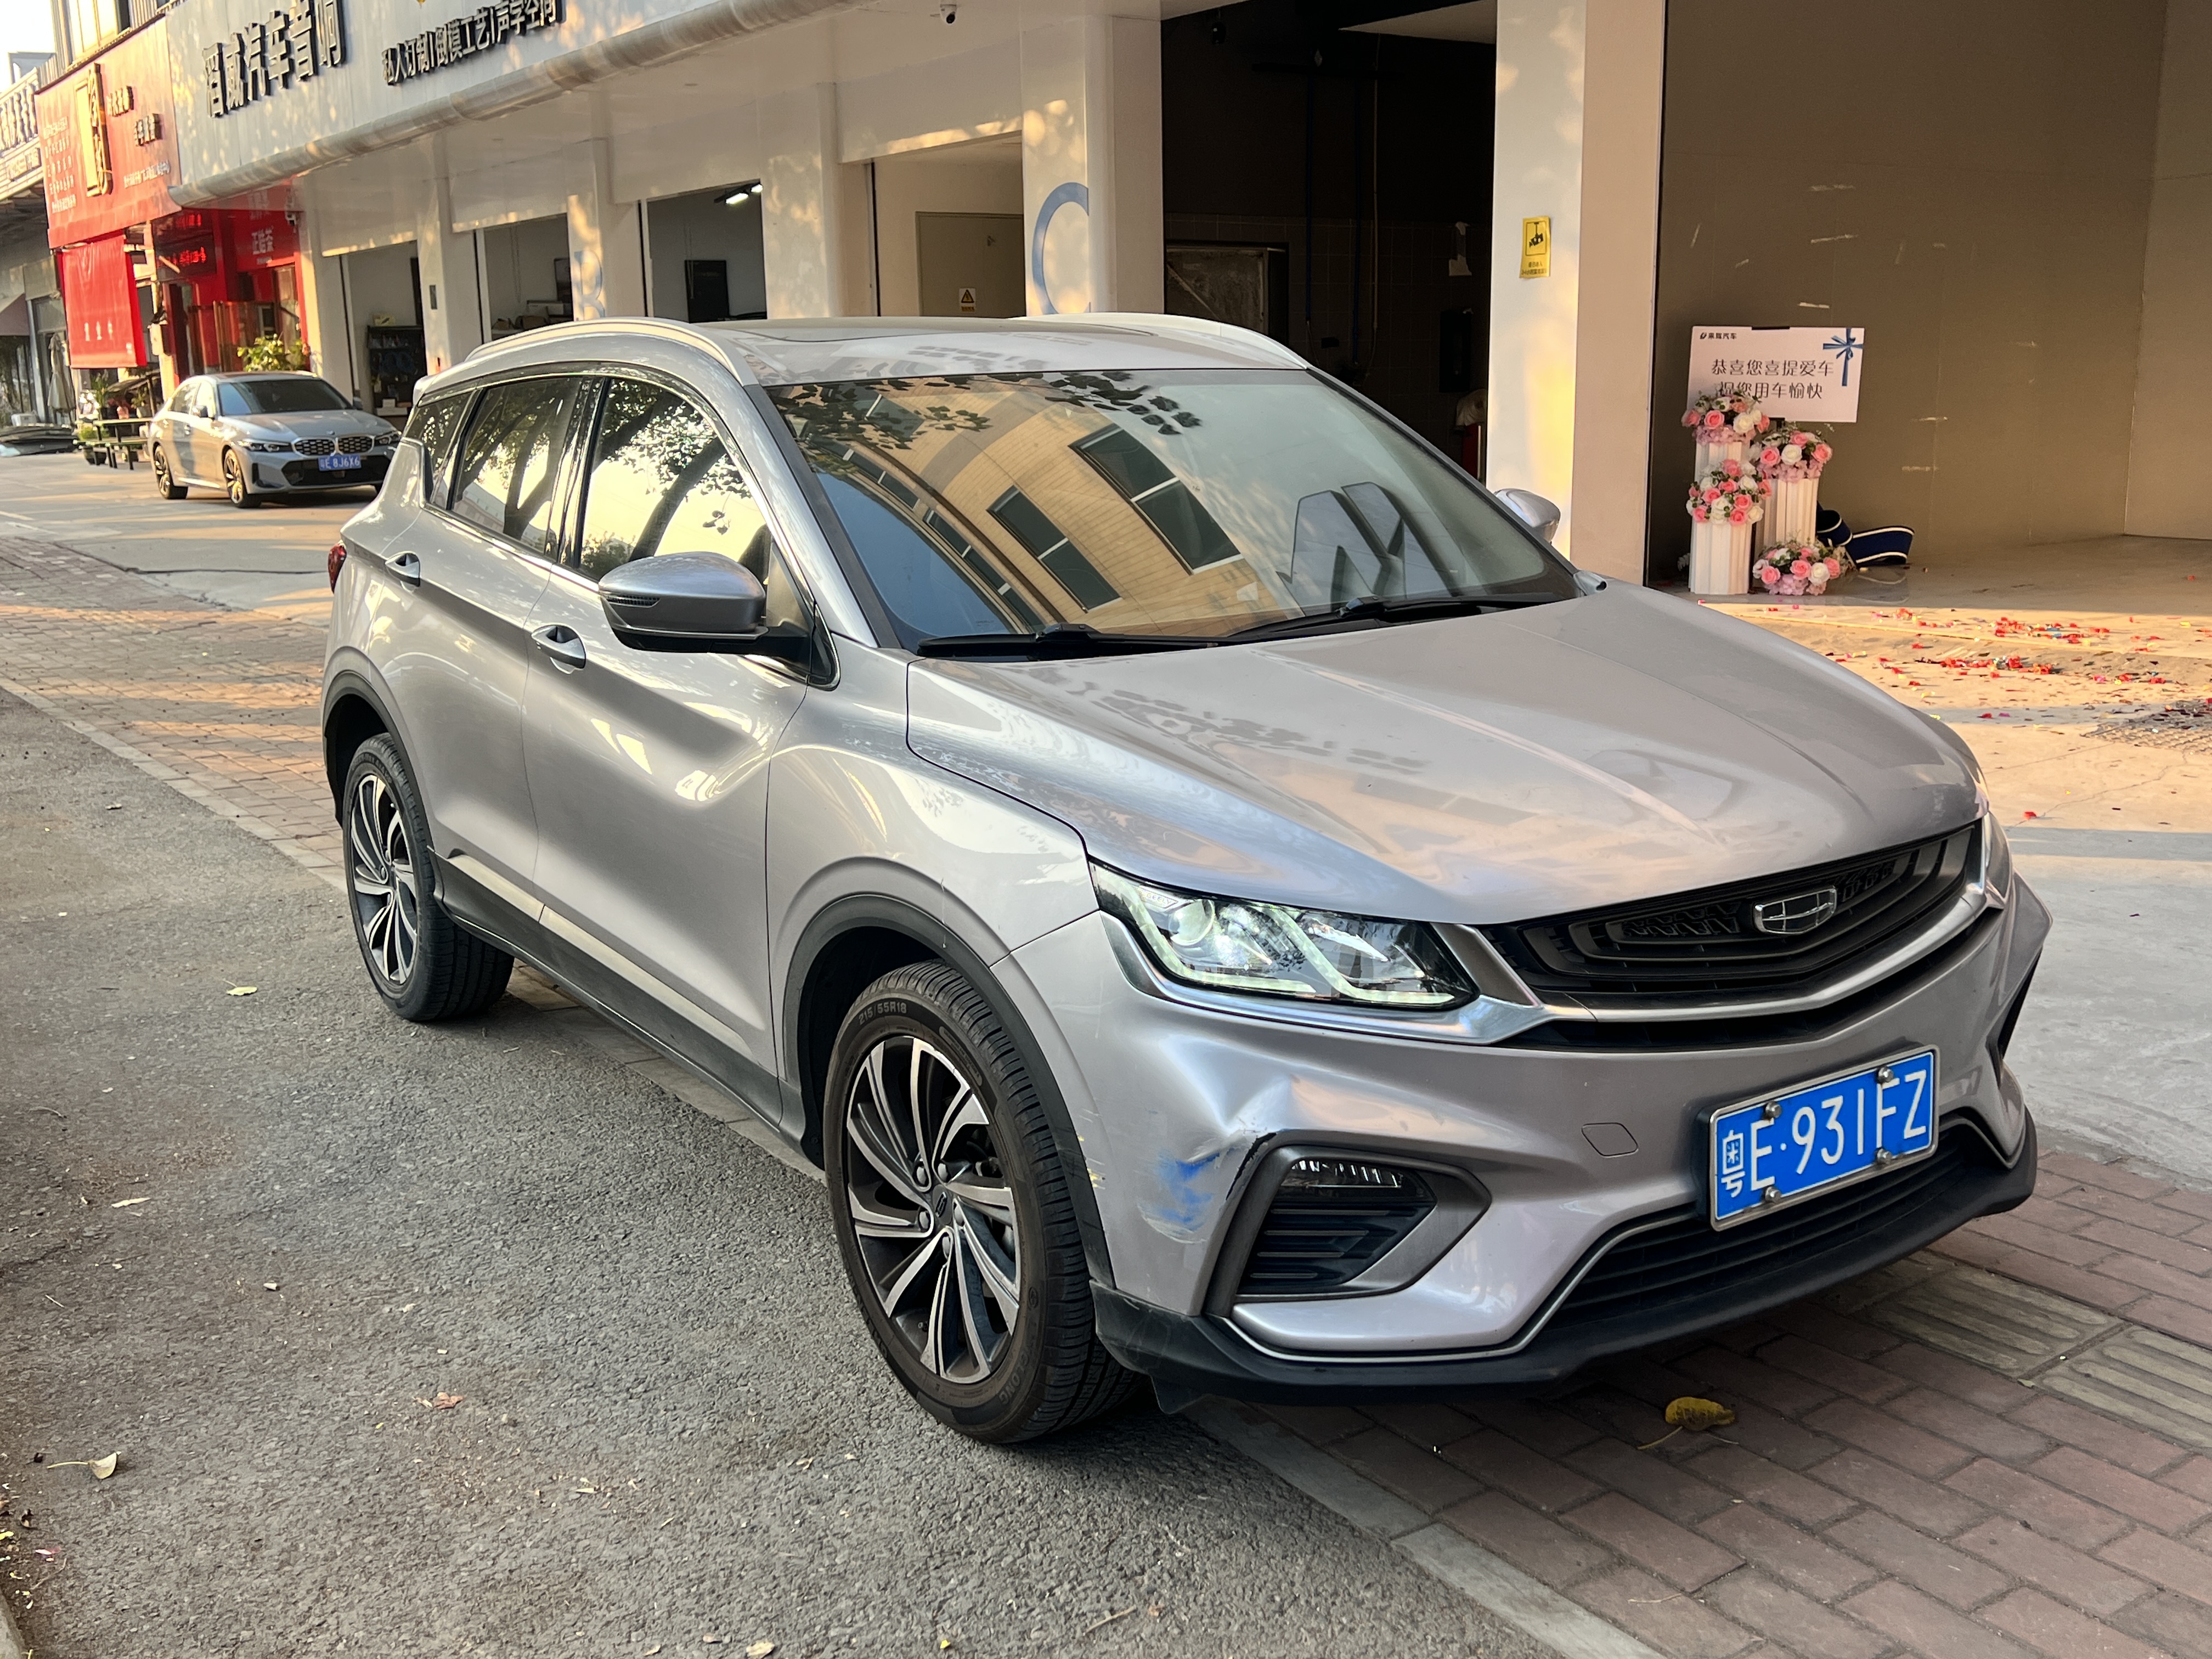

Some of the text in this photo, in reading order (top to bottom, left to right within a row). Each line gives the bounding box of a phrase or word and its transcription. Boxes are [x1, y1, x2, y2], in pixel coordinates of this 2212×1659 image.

[1712, 359, 1834, 376] 恭喜您喜提爱车
[859, 1001, 907, 1025] 215/55R18
